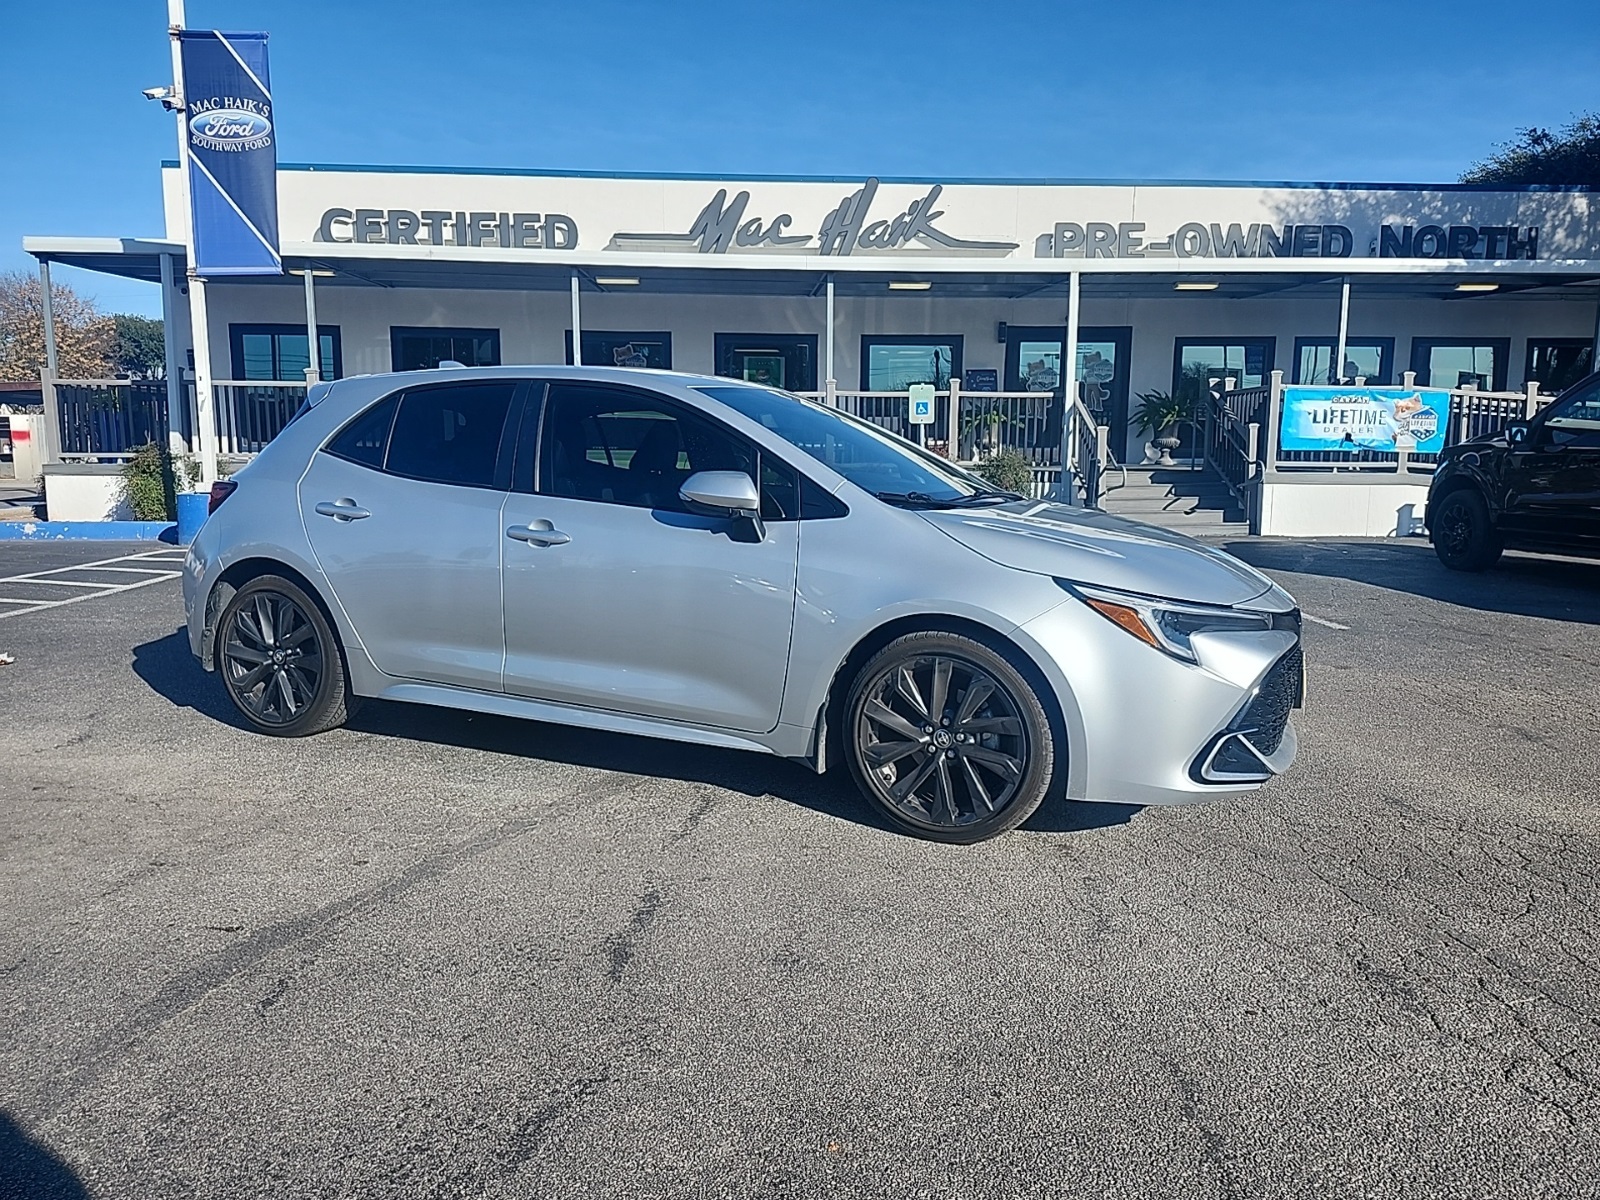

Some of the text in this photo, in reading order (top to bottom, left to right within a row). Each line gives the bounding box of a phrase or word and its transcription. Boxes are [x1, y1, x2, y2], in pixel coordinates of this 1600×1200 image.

[189, 97, 270, 117] MAC HAIK'S
[205, 114, 254, 136] Ford
[191, 135, 271, 152] SOUTHWAY FORD
[320, 176, 1539, 260] CERTIFIED Mac Haik PRE-OWNED NORTH
[1313, 408, 1387, 425] LIFETIME
